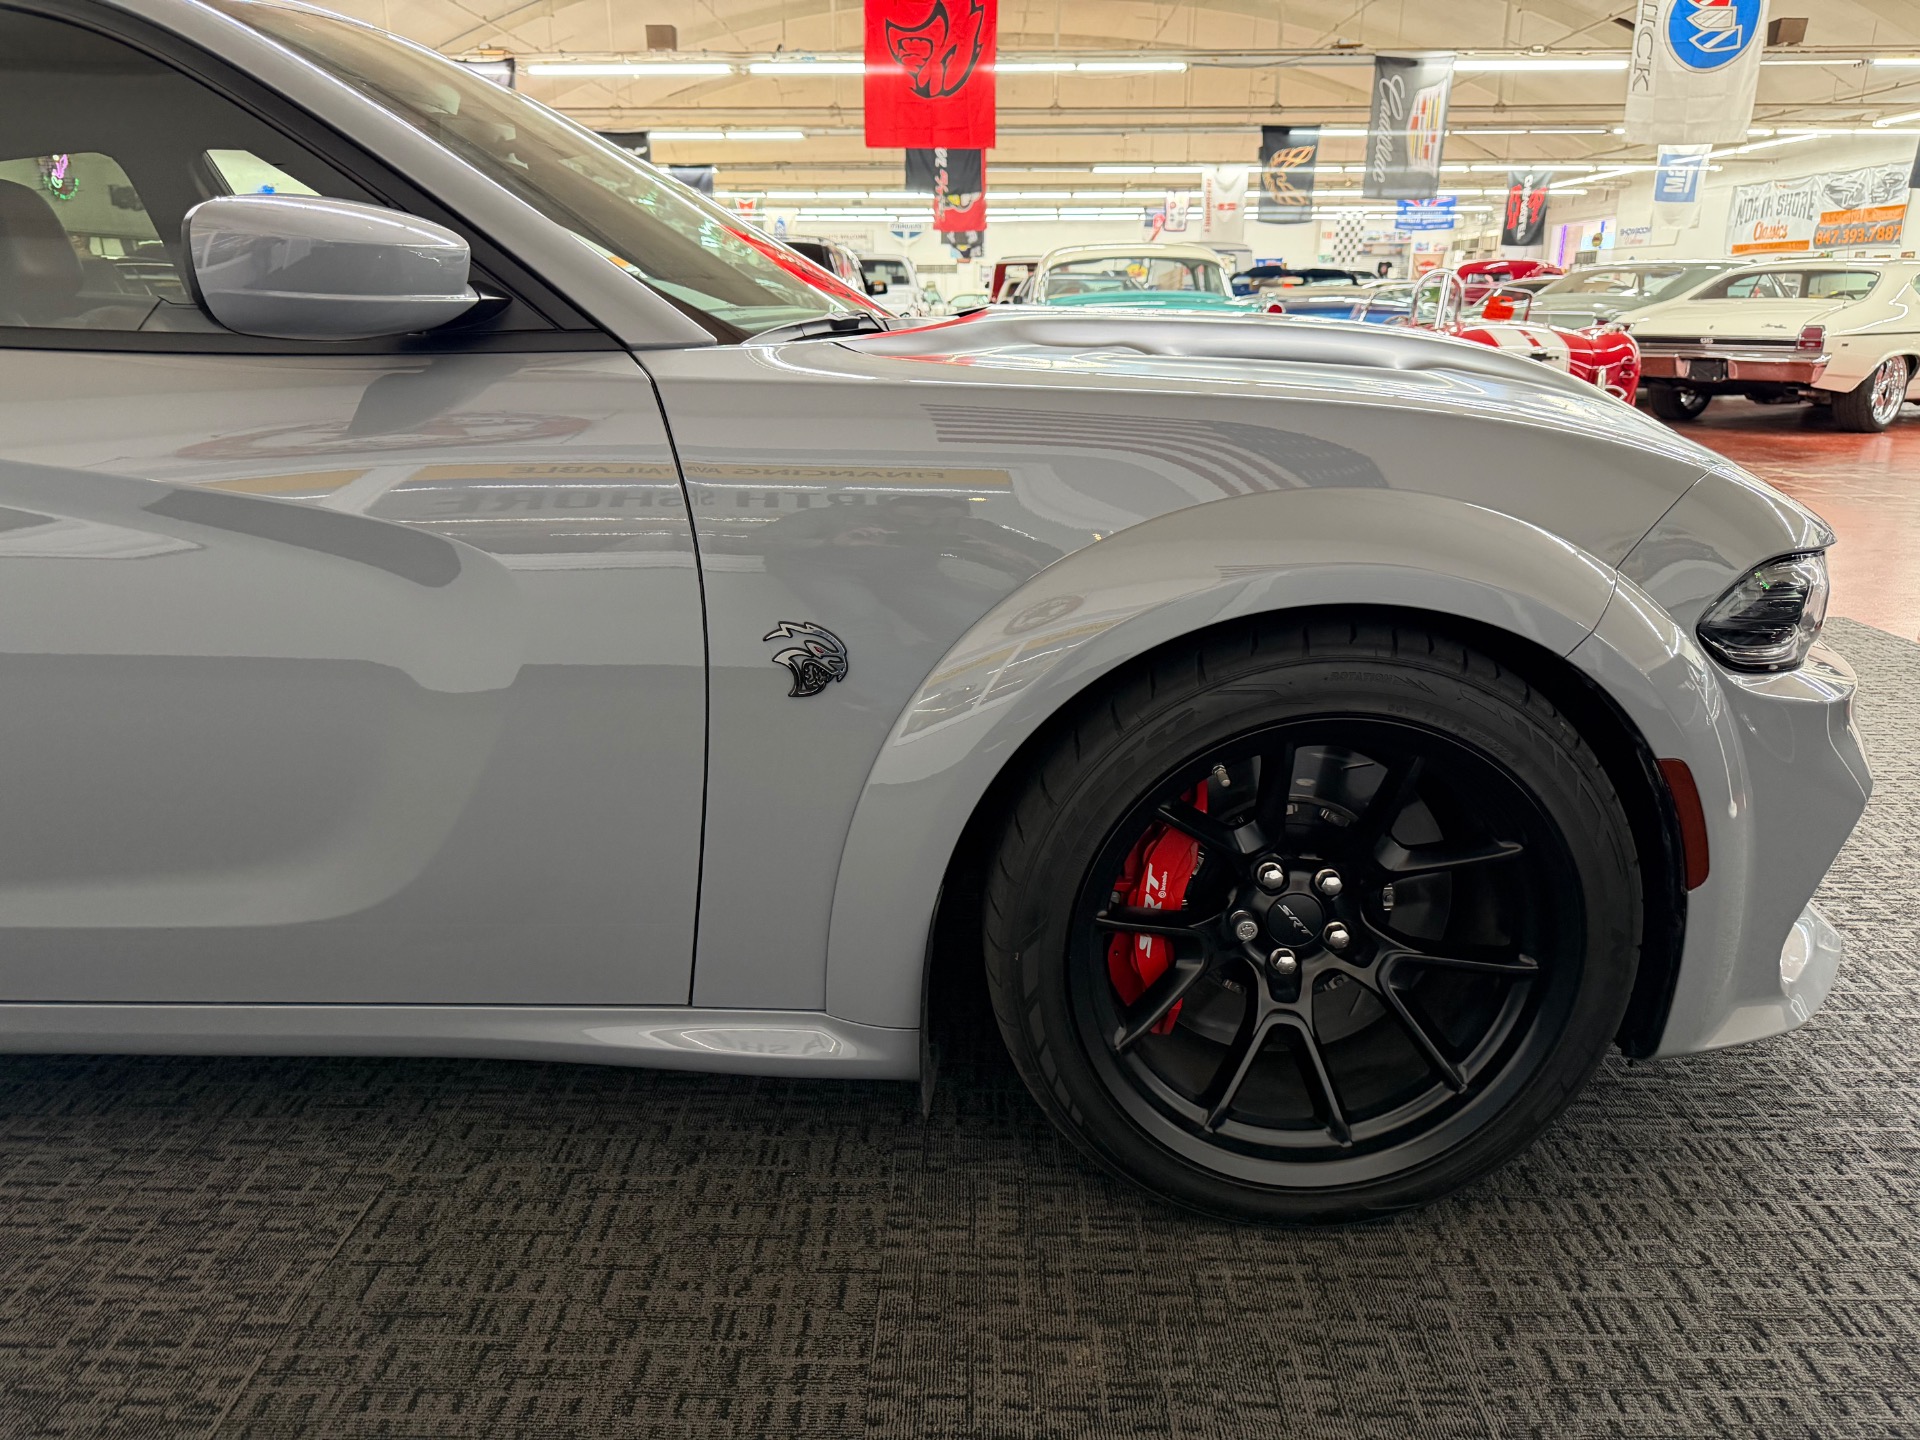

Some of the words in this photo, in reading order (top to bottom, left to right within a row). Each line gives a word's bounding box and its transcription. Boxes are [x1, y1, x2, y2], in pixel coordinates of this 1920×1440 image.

[1372, 74, 1406, 184] Cadillac
[1734, 191, 1773, 227] NORTH
[1776, 190, 1817, 220] SHORE
[1754, 219, 1788, 241] Classics
[1815, 225, 1902, 245] 847.393.7887
[1159, 871, 1169, 891] brembo
[1276, 903, 1315, 937] SRT
